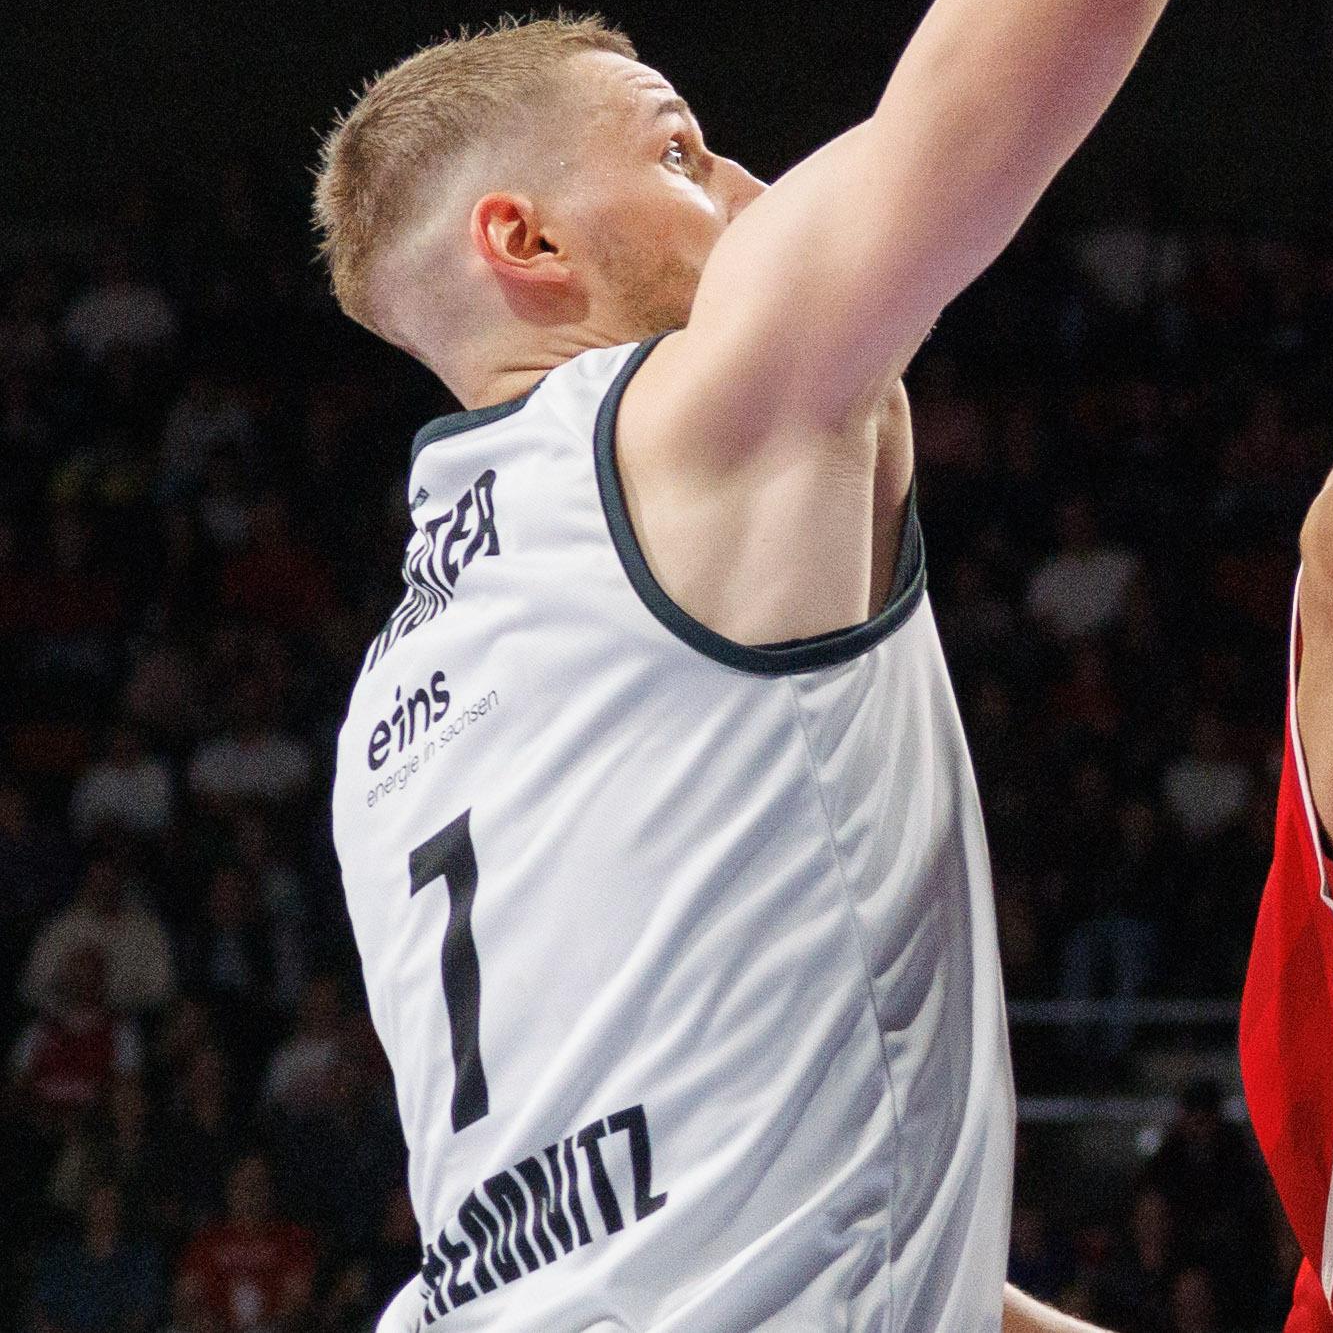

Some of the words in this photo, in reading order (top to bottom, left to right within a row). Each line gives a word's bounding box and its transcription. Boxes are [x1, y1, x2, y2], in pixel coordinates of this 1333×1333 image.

[367, 755, 420, 808] energie
[424, 741, 436, 764] in
[440, 690, 499, 748] sachsen
[368, 670, 451, 771] eins
[409, 807, 489, 1134] 7
[420, 1103, 668, 1326] HEMNITZ
